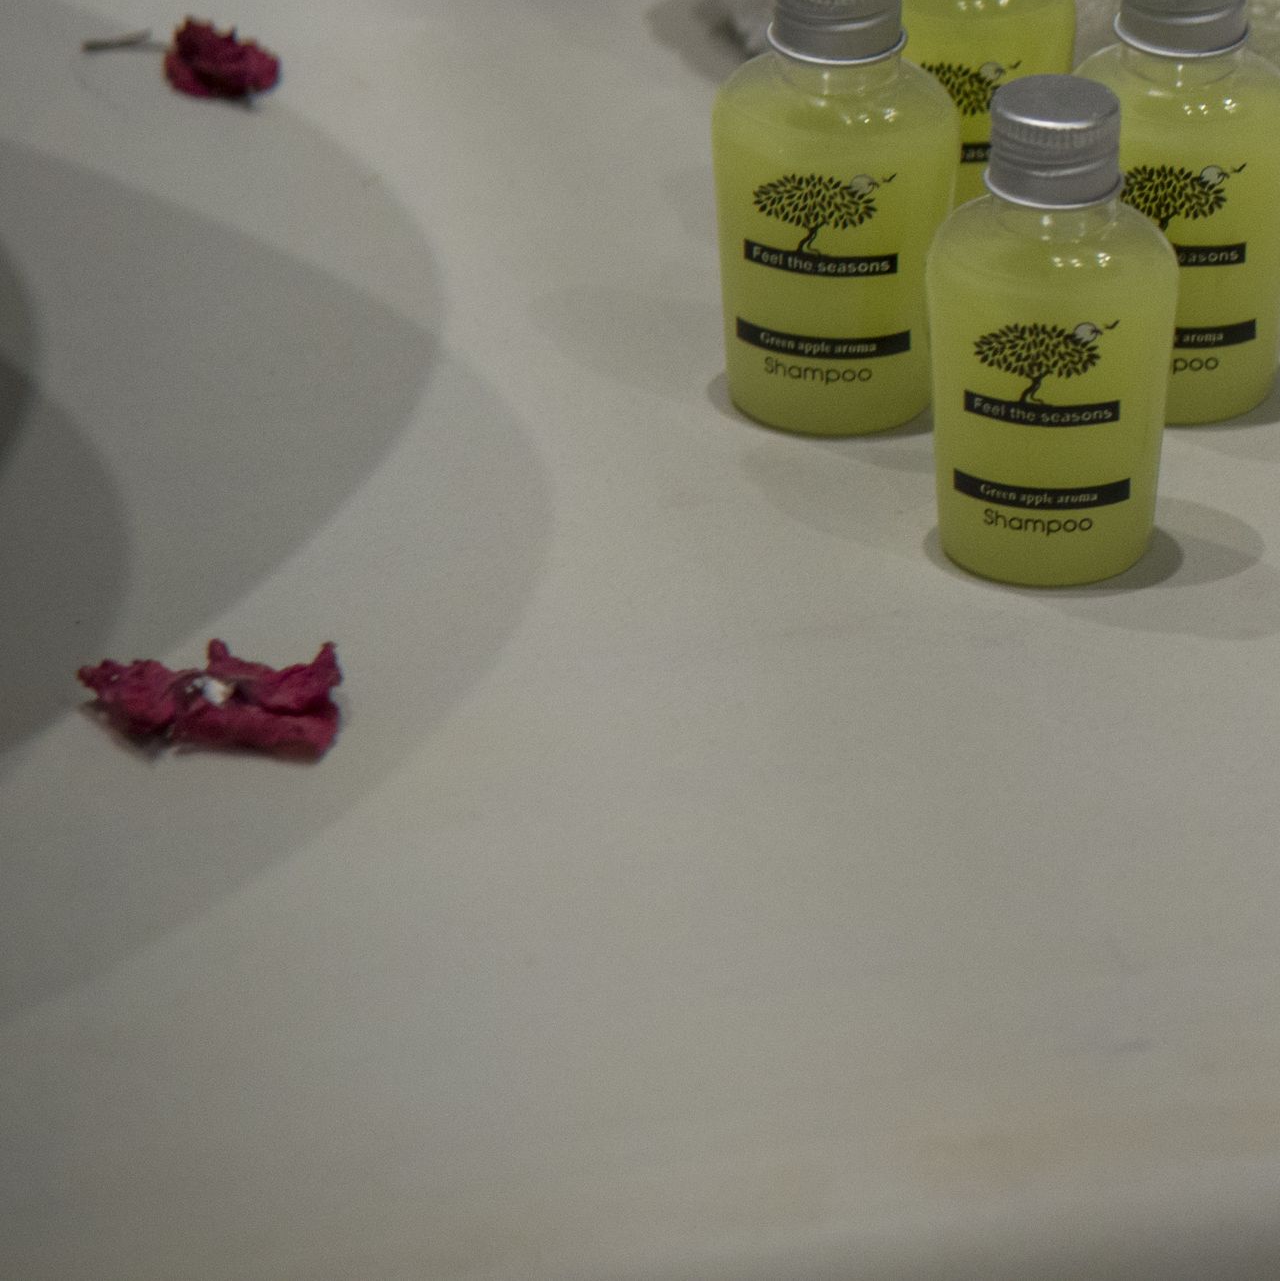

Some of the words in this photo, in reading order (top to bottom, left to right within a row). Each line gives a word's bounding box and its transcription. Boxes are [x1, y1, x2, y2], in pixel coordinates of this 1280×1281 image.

[752, 246, 784, 265] Feel
[788, 255, 812, 270] the
[817, 259, 891, 274] seasons
[1179, 250, 1240, 263] easons
[760, 332, 795, 348] Green
[798, 342, 831, 355] apple
[834, 342, 877, 354] aroma
[764, 356, 873, 385] Shampoo
[974, 397, 1006, 414] Feel
[1010, 407, 1036, 422] the
[1041, 408, 1113, 423] seasons
[980, 483, 1016, 501] Green
[1019, 491, 1053, 505] apple
[1057, 492, 1098, 504] aroma
[983, 508, 1093, 536] Shampoo
